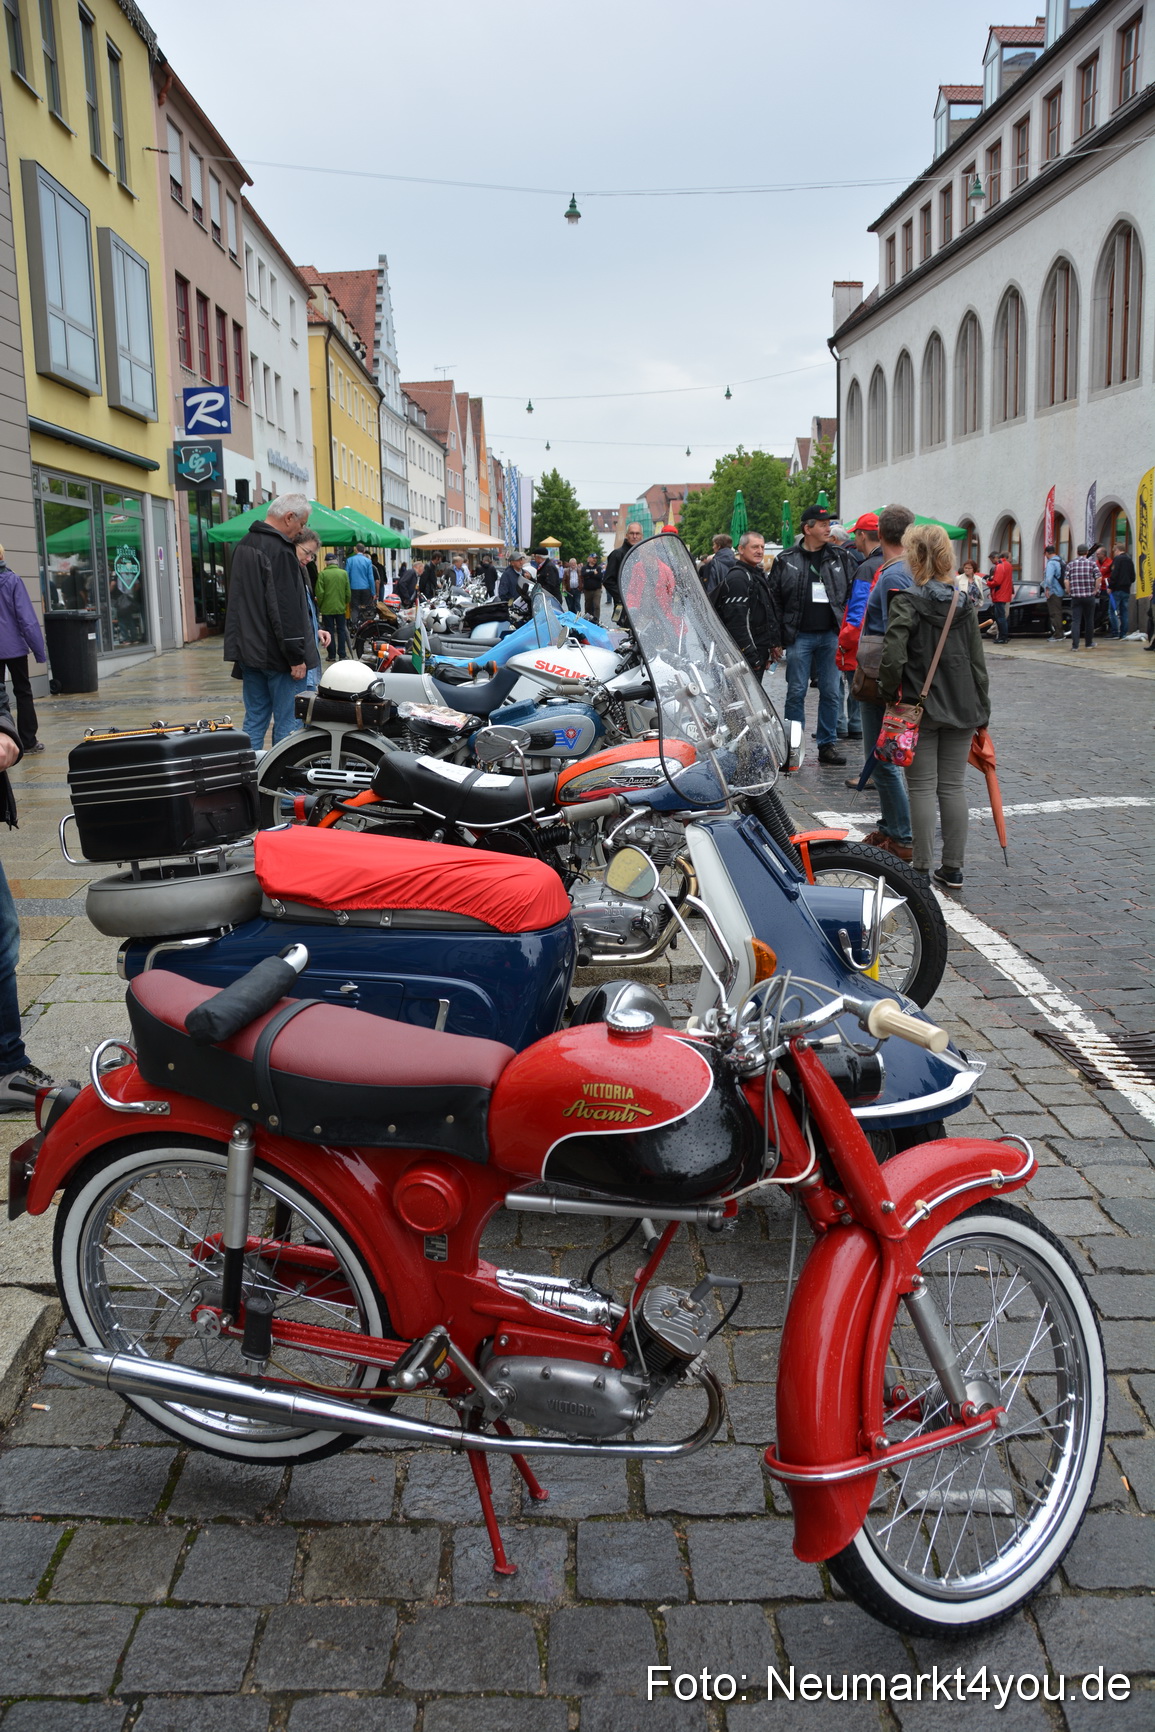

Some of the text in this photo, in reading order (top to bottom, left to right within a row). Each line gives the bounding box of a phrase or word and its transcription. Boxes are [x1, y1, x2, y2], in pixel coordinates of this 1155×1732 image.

[188, 453, 206, 474] G2
[534, 659, 591, 679] SUZUK
[582, 1083, 634, 1100] VICTORIA
[562, 1099, 652, 1123] Avanti
[547, 1399, 597, 1417] VICTORIA
